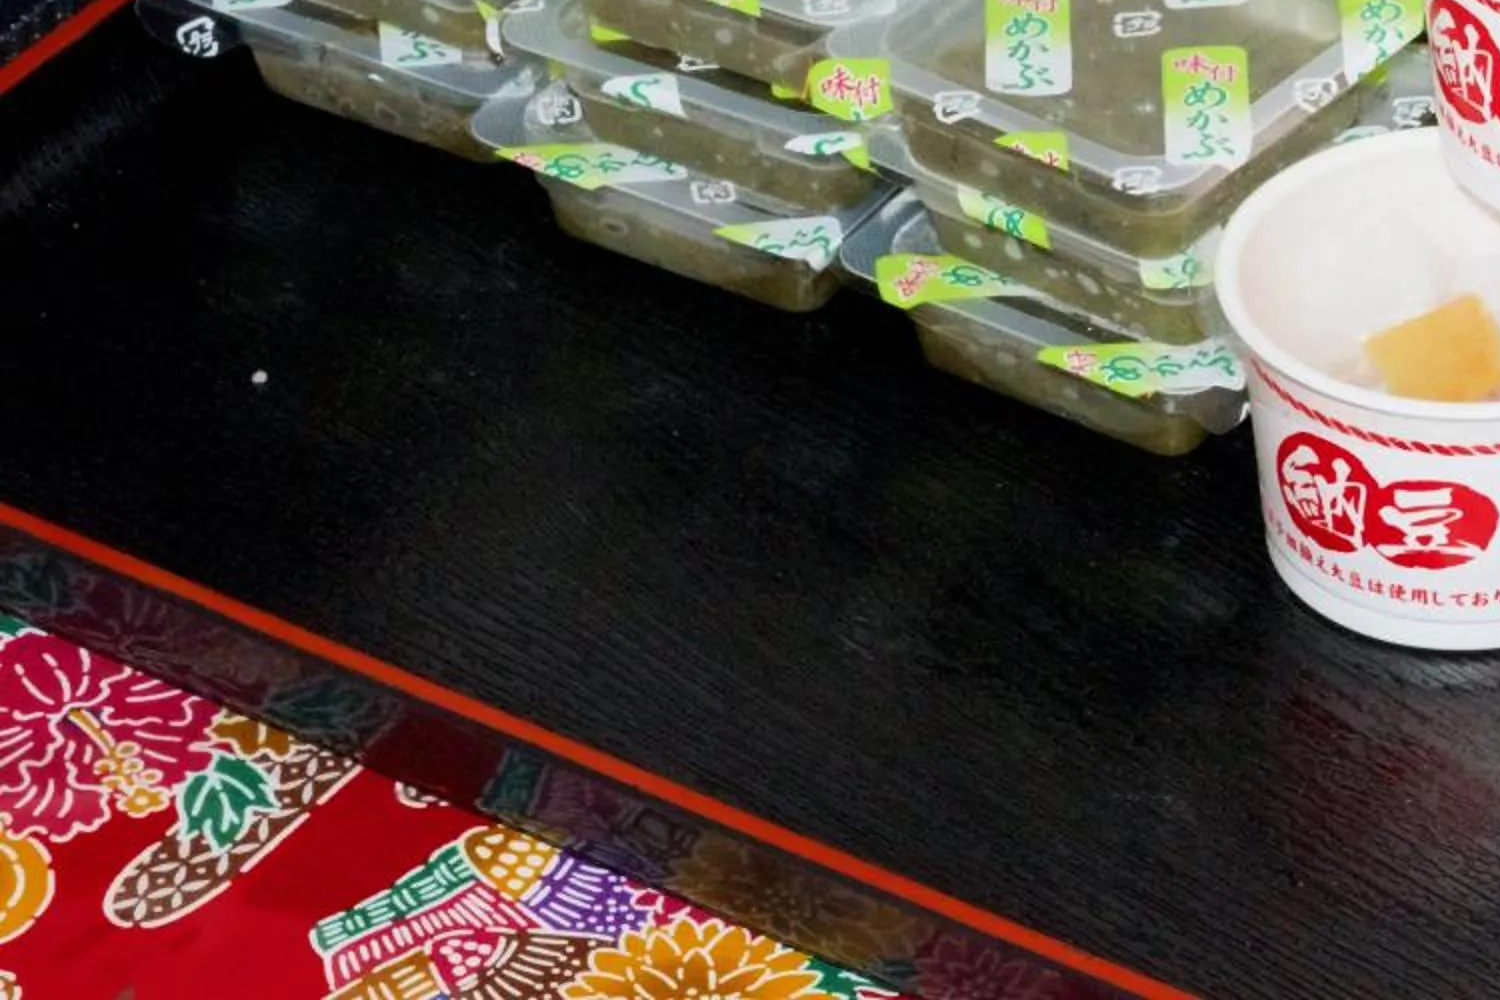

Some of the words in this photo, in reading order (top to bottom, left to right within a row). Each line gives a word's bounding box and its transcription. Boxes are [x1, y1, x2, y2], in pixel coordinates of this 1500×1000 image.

[821, 66, 880, 106] 味付
[1003, 12, 1055, 90] めかぶ
[1181, 81, 1235, 160] めかぶ
[1101, 346, 1236, 382] めかぶ
[1281, 444, 1488, 558] 納豆
